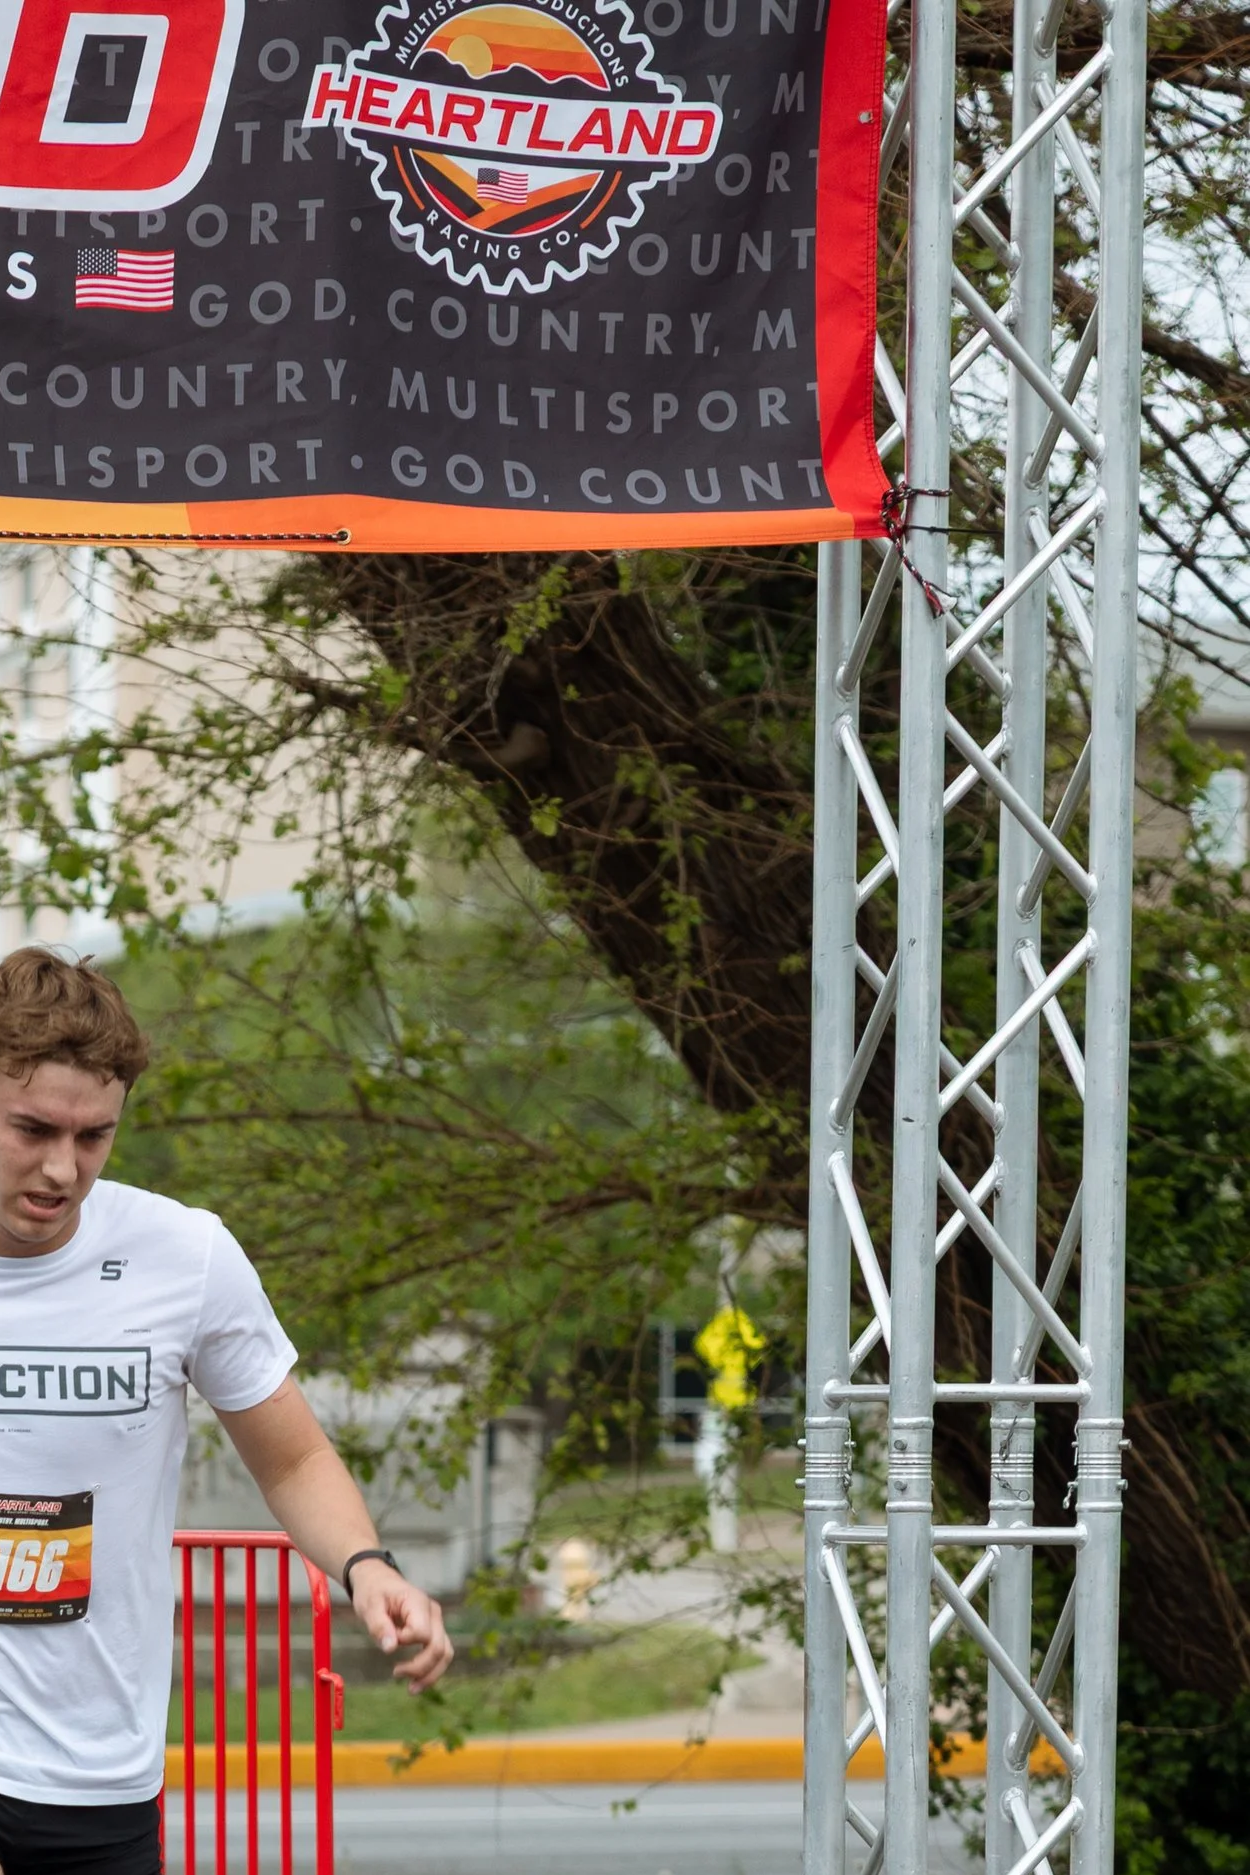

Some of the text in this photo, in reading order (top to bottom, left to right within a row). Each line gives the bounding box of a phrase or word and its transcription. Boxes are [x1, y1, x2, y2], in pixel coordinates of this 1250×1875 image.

[311, 71, 716, 156] HEARTLAND
[426, 209, 521, 260] RACING
[539, 230, 579, 253] CO.
[387, 288, 720, 358] COUNTRY,
